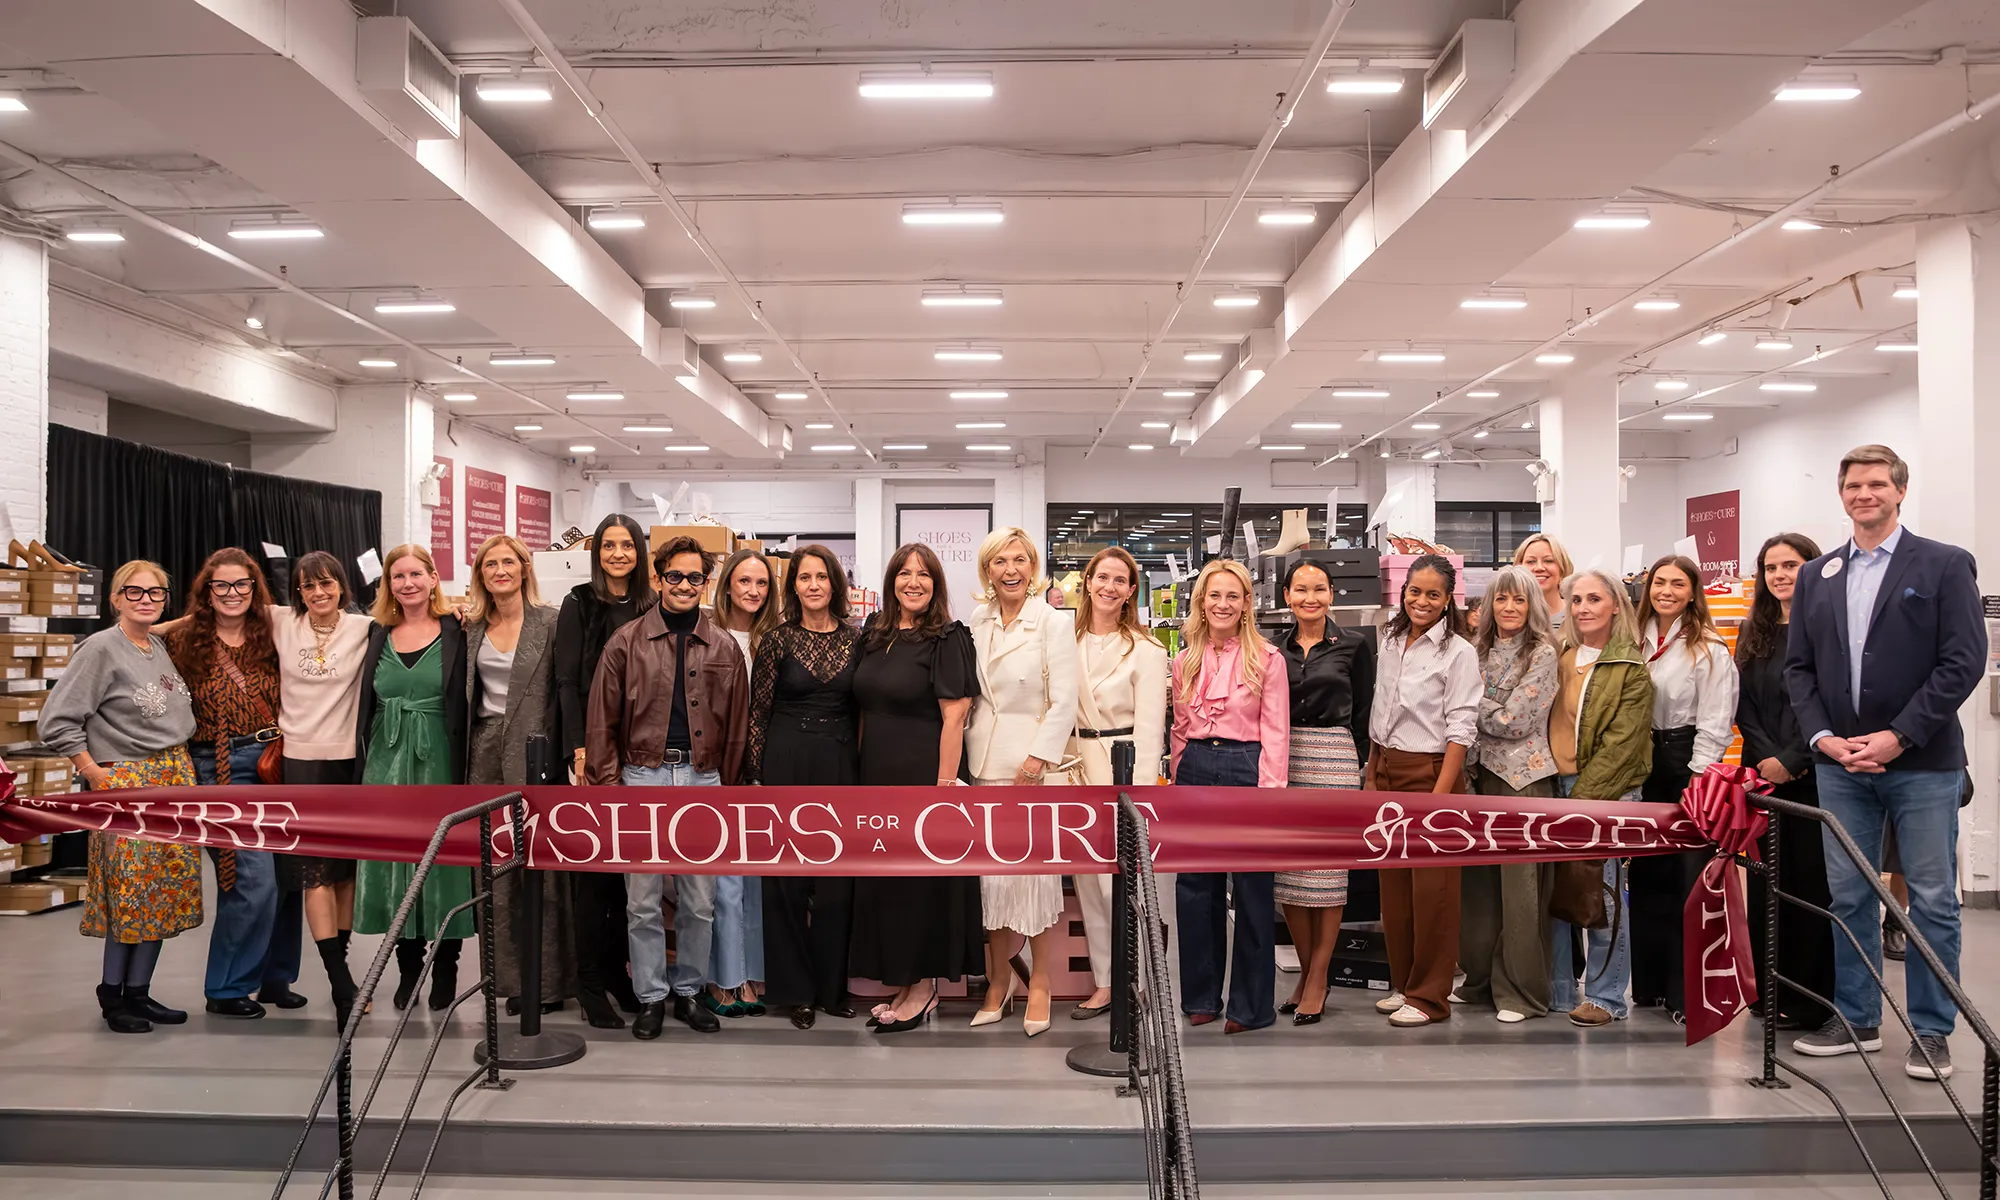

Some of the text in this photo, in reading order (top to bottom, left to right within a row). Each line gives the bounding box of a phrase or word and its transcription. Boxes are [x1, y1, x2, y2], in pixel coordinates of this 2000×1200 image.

[1693, 510, 1714, 522] SHOES
[1717, 507, 1735, 519] CURE
[918, 531, 972, 543] SHOES
[1707, 530, 1716, 546] &
[937, 550, 973, 562] URE
[856, 815, 900, 830] FOR
[546, 801, 844, 865] SHOES
[872, 838, 887, 853] A
